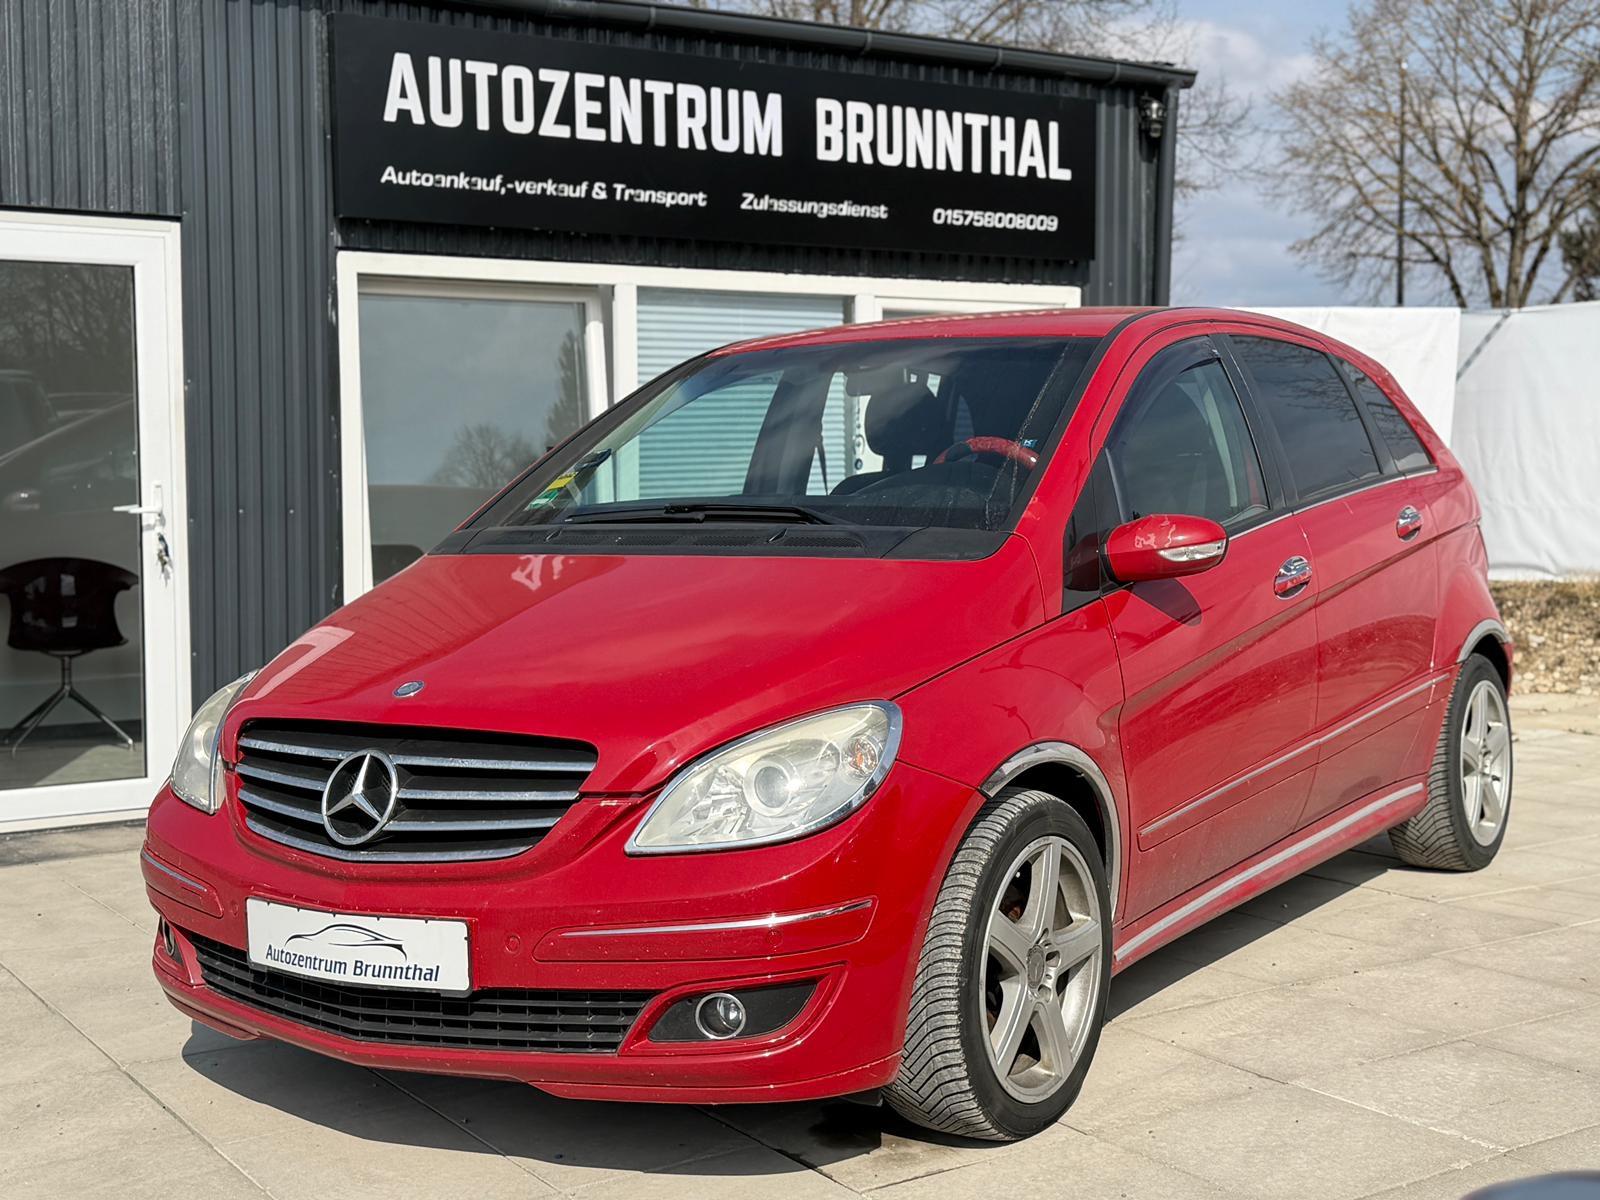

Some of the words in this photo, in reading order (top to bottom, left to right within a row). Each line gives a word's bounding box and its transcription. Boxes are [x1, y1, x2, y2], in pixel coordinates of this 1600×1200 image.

[383, 51, 783, 157] AUTOZENTRUM
[815, 97, 1072, 181] BRUNNTHAL
[591, 181, 608, 200] &
[612, 183, 707, 208] Transport
[740, 192, 888, 219] Zulassungsdienst
[932, 207, 1058, 232] 015758008009
[265, 944, 347, 975] Autozentrum
[353, 960, 440, 982] Brunnthal
